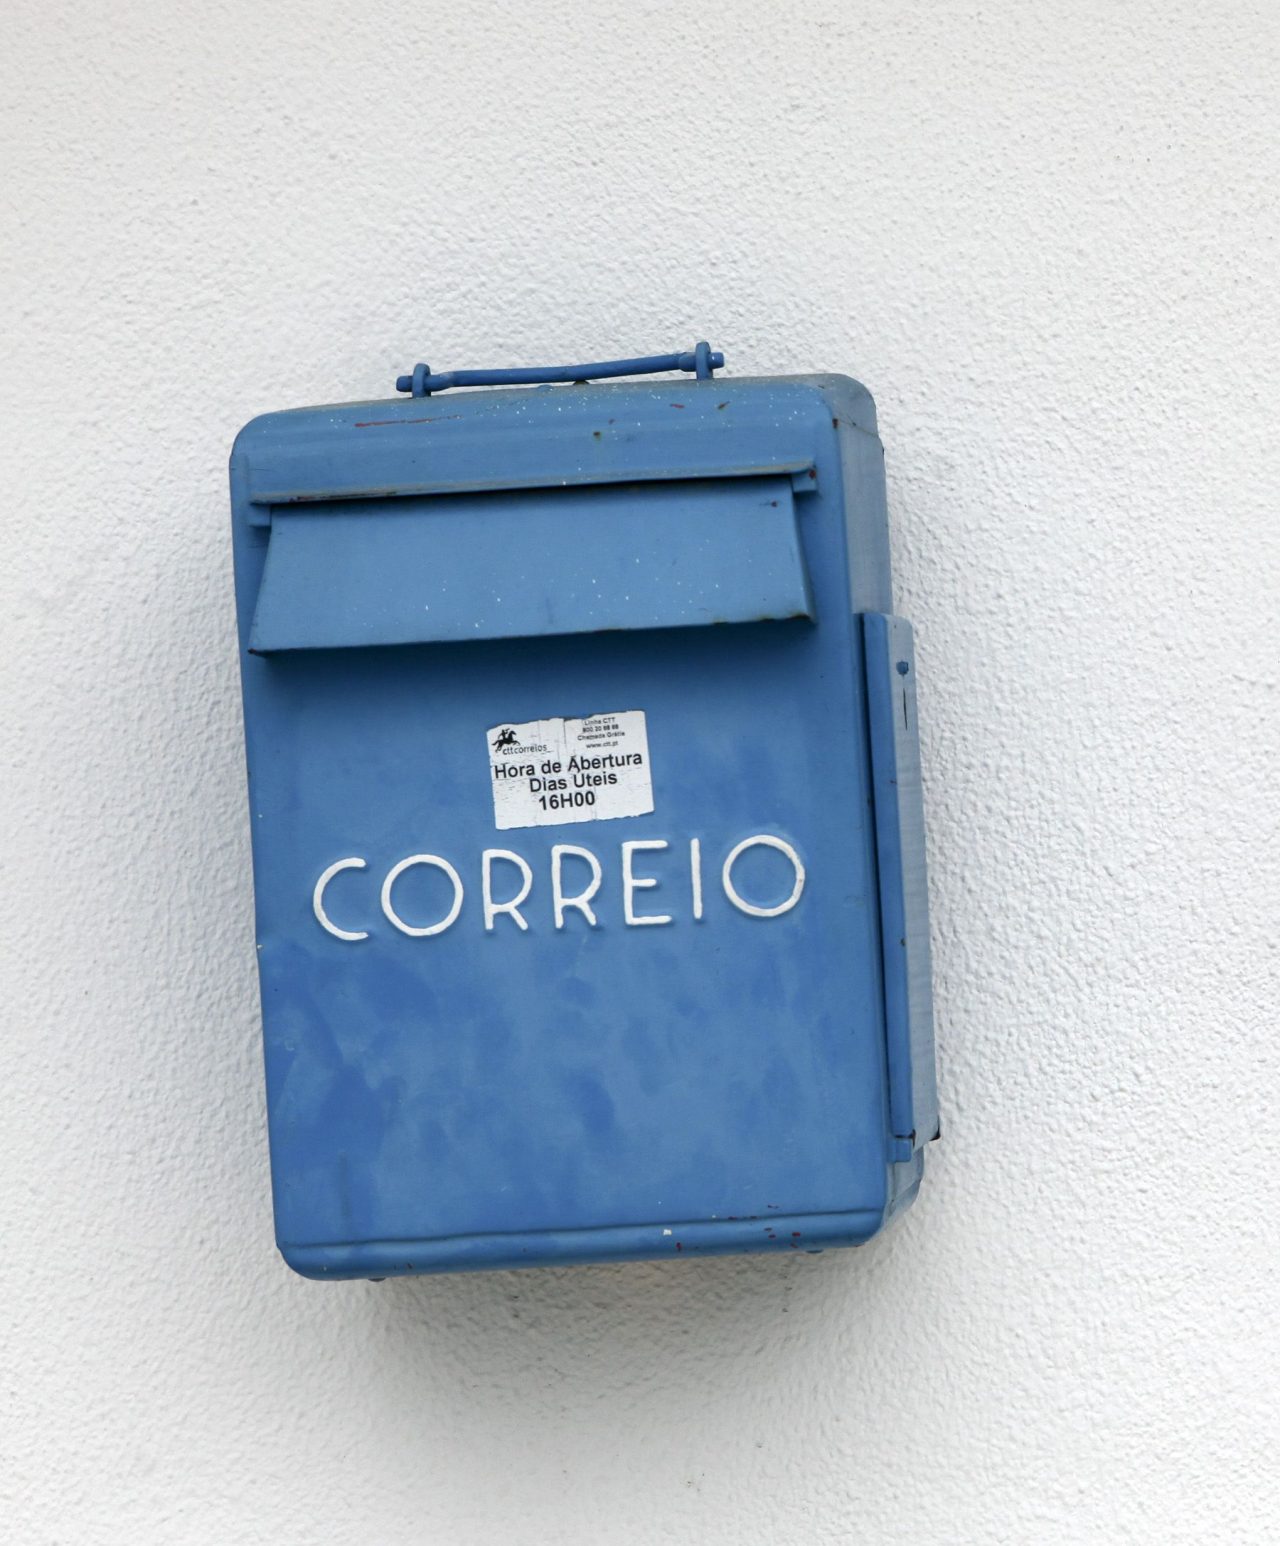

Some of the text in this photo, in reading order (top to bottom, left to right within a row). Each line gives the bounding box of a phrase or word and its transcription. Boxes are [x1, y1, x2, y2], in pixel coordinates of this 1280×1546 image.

[602, 716, 616, 724] CTT
[495, 753, 643, 779] Hora de Abertura
[530, 777, 567, 793] Dias
[538, 791, 596, 811] 16H00
[313, 834, 805, 941] CORREIO
